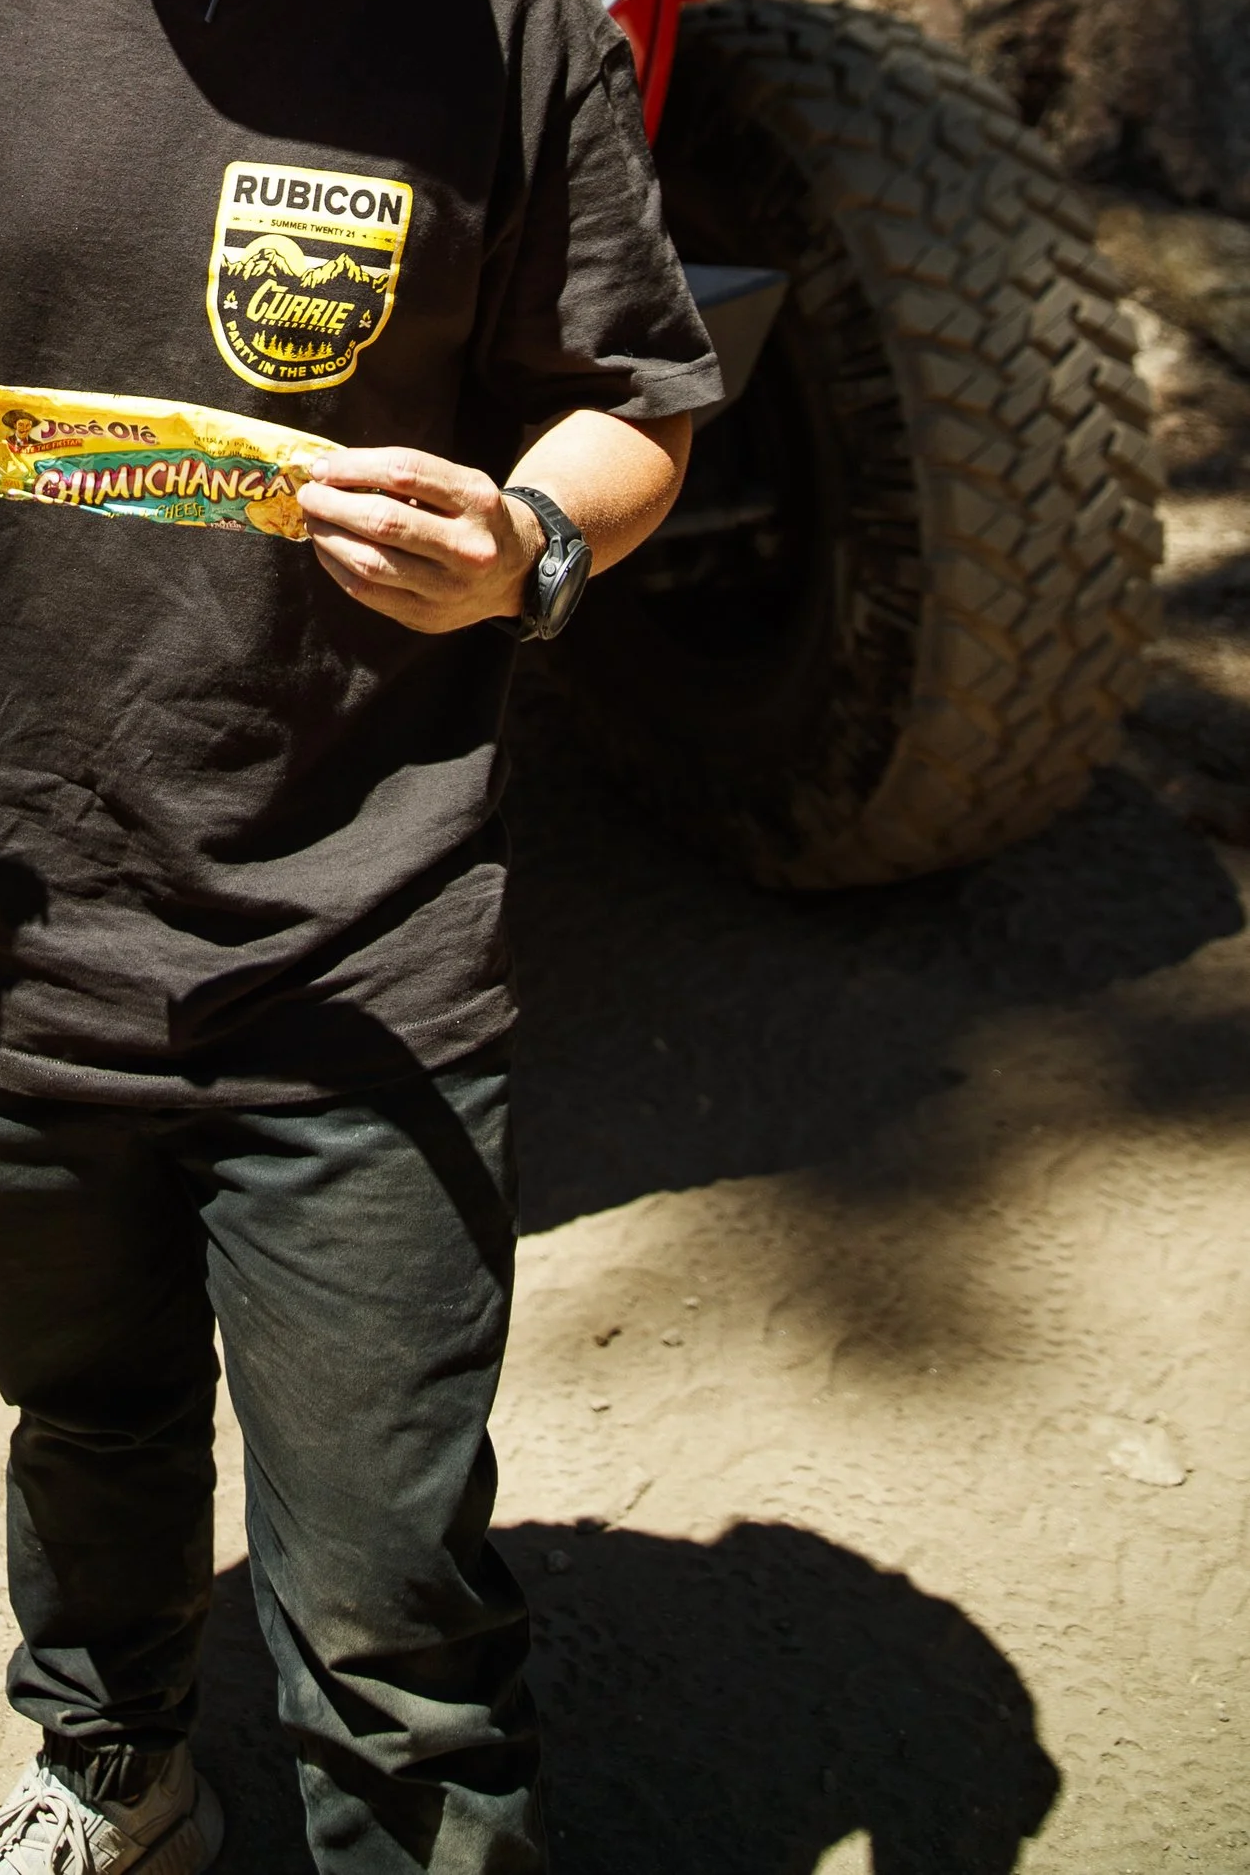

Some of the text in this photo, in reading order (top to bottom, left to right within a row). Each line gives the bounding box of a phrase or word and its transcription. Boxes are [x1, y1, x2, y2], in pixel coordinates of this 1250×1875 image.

[233, 174, 403, 225] RUBICON
[270, 219, 356, 238] SUMMER TWENTY 21
[246, 279, 355, 329] CURRIE
[261, 319, 342, 335] ENTERPRISES
[226, 320, 356, 377] PARTY IN THE WOODS
[34, 460, 291, 506] CHIMICHANGA
[156, 502, 206, 519] CHEESE
